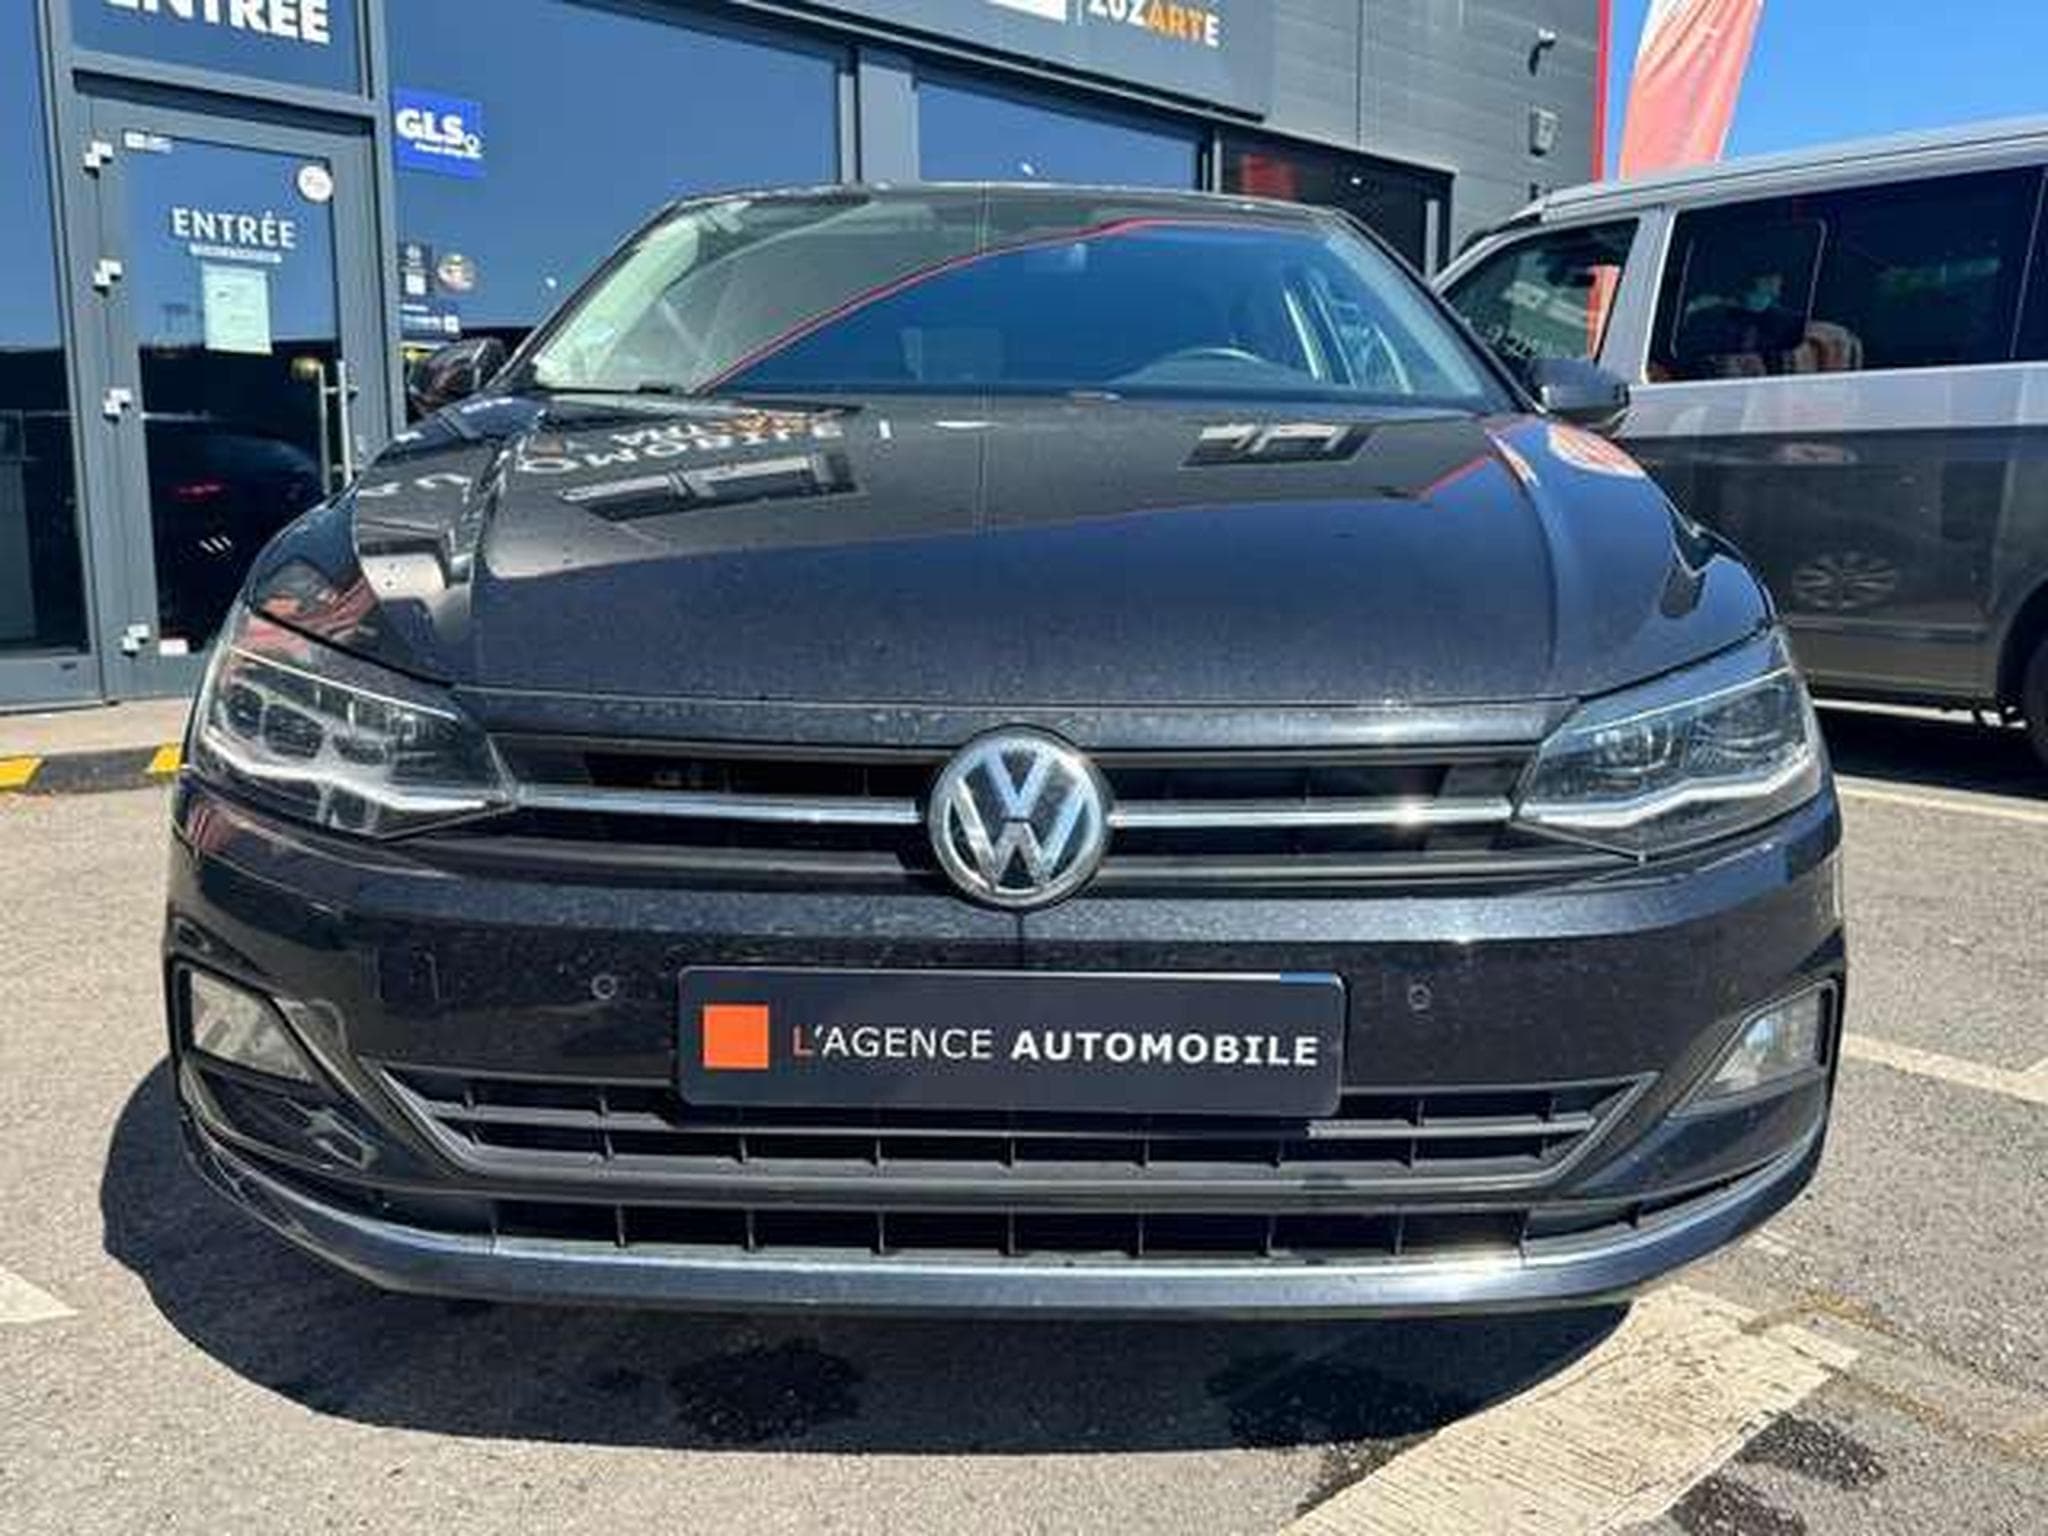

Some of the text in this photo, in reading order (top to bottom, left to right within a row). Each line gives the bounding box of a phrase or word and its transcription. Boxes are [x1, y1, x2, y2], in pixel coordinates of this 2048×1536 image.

[396, 109, 464, 144] GLS
[172, 207, 296, 249] ENTRÉE
[793, 1025, 1318, 1066] L'AGENCE AUTOMOBILE
